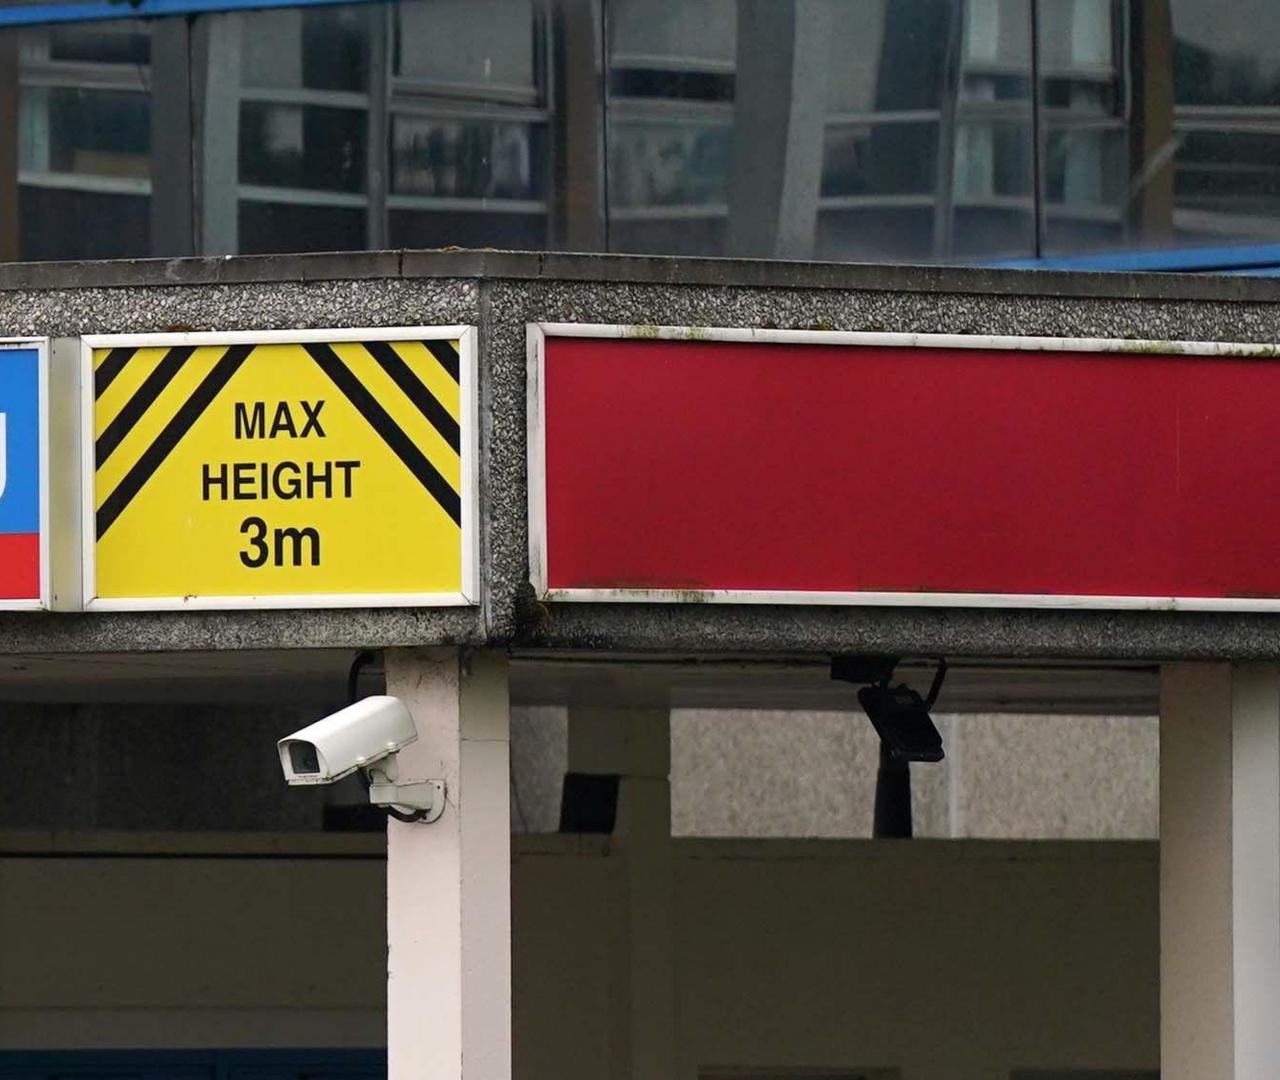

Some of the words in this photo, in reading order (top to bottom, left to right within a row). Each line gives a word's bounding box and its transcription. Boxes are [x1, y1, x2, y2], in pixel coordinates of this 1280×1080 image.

[234, 400, 327, 439] MAX
[201, 460, 361, 500] HEIGHT
[239, 516, 321, 568] 3m
